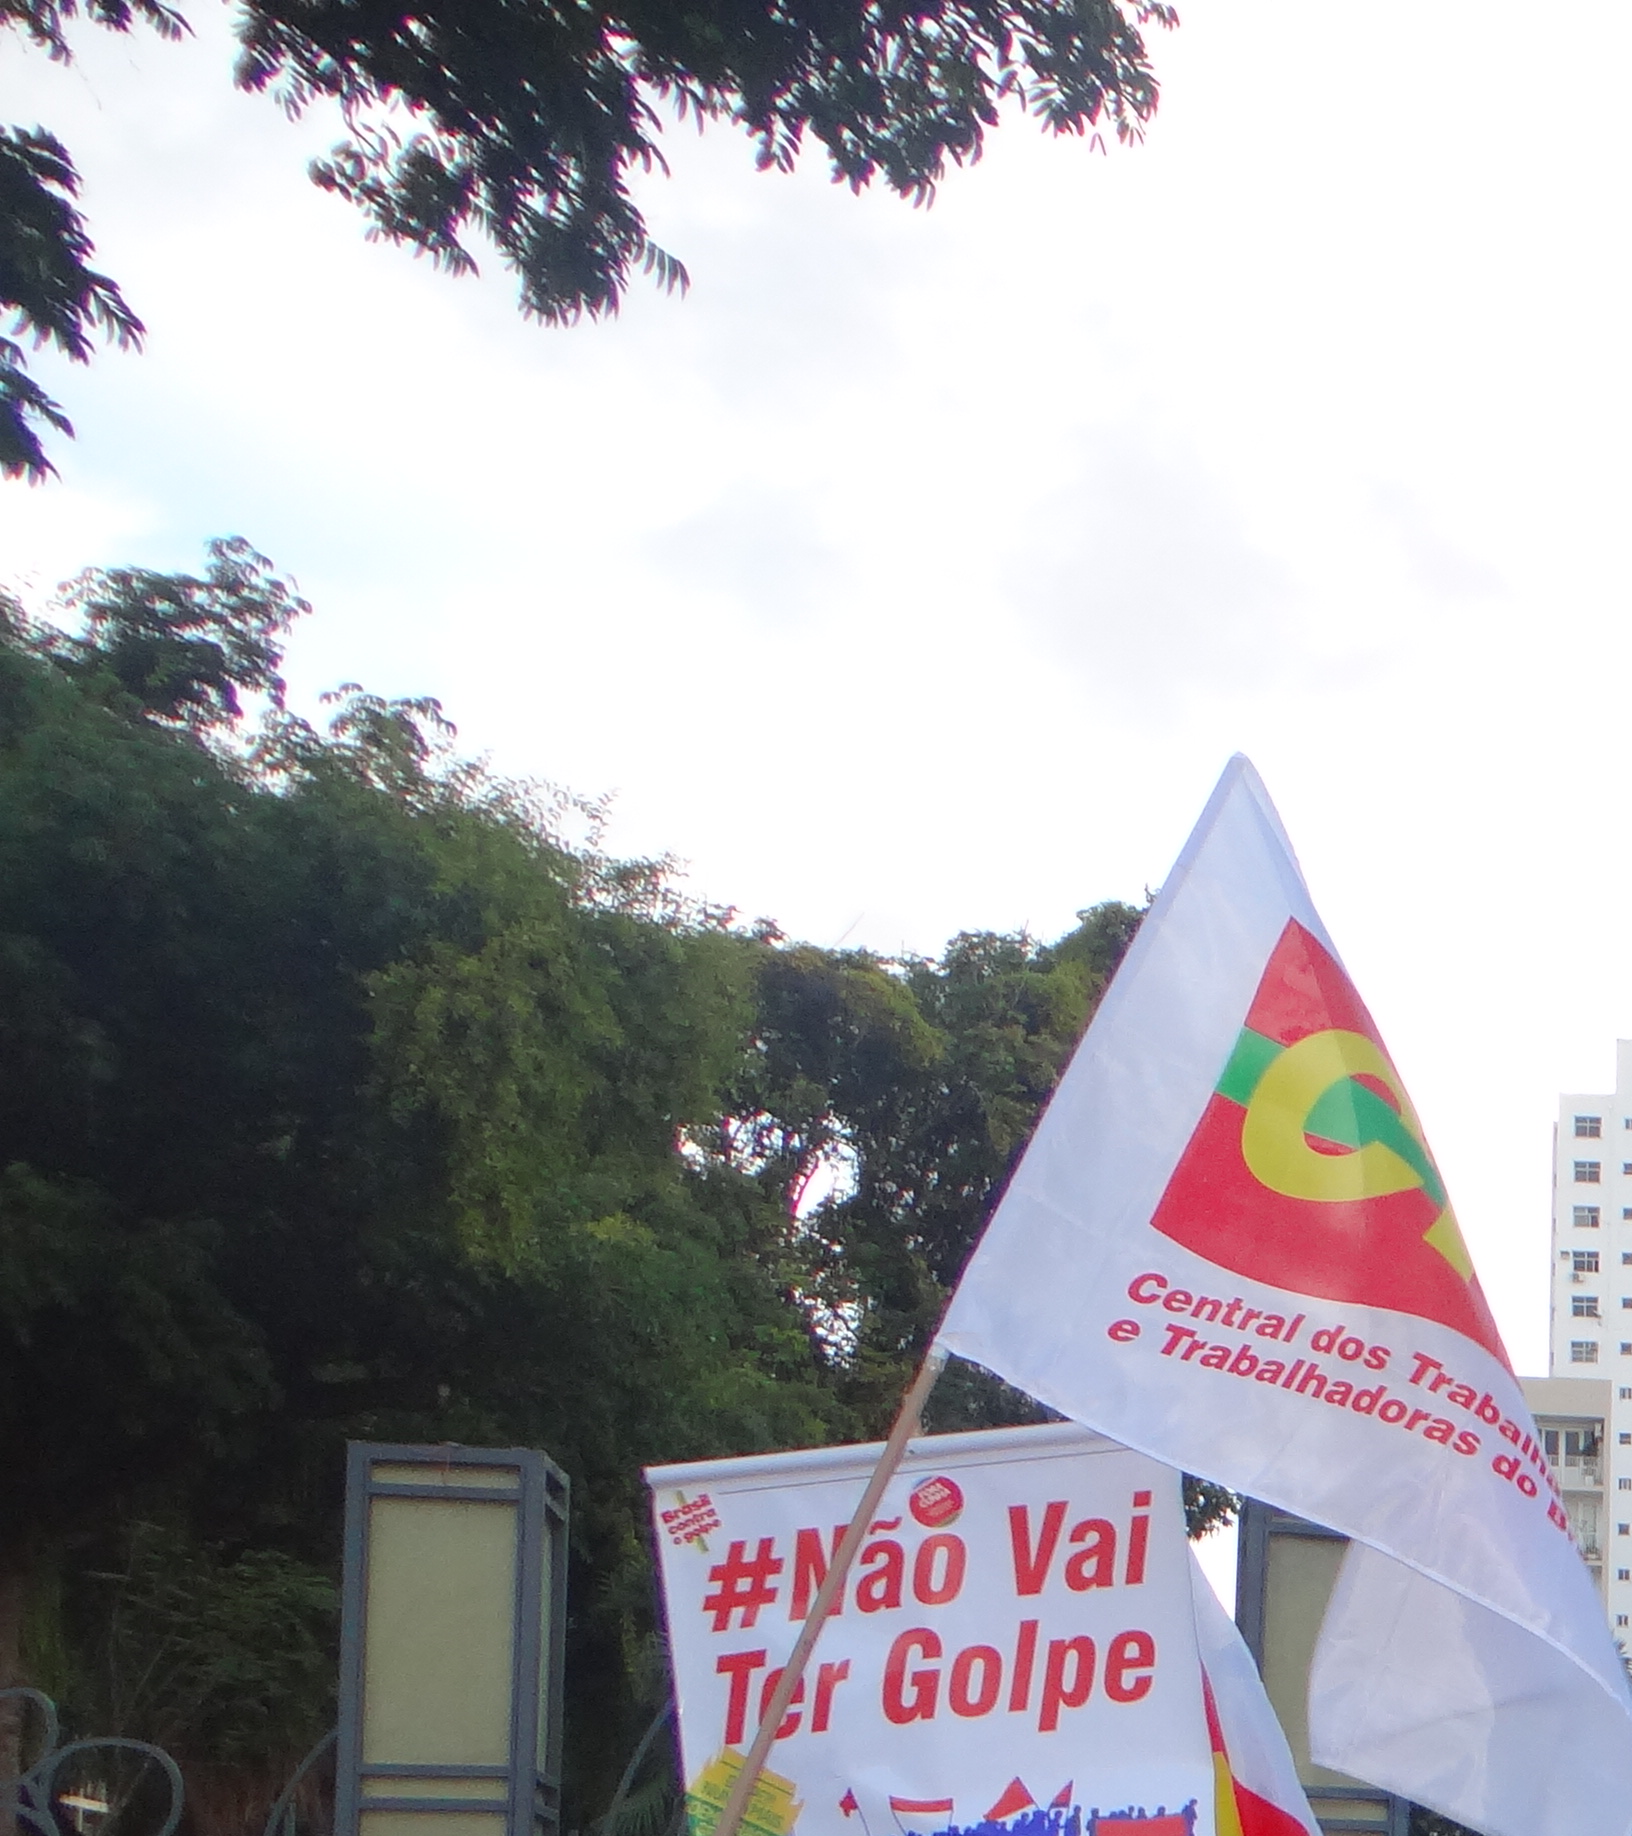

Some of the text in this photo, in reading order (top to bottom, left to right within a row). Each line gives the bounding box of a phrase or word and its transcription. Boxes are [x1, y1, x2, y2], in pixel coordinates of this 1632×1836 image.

[1127, 1272, 1306, 1343] Central
[1310, 1325, 1392, 1371] dos
[1108, 1319, 1538, 1499] e Trabalhadoras do
[702, 1491, 1152, 1633] #Não Vai
[715, 1620, 1156, 1746] Ter Golpe
